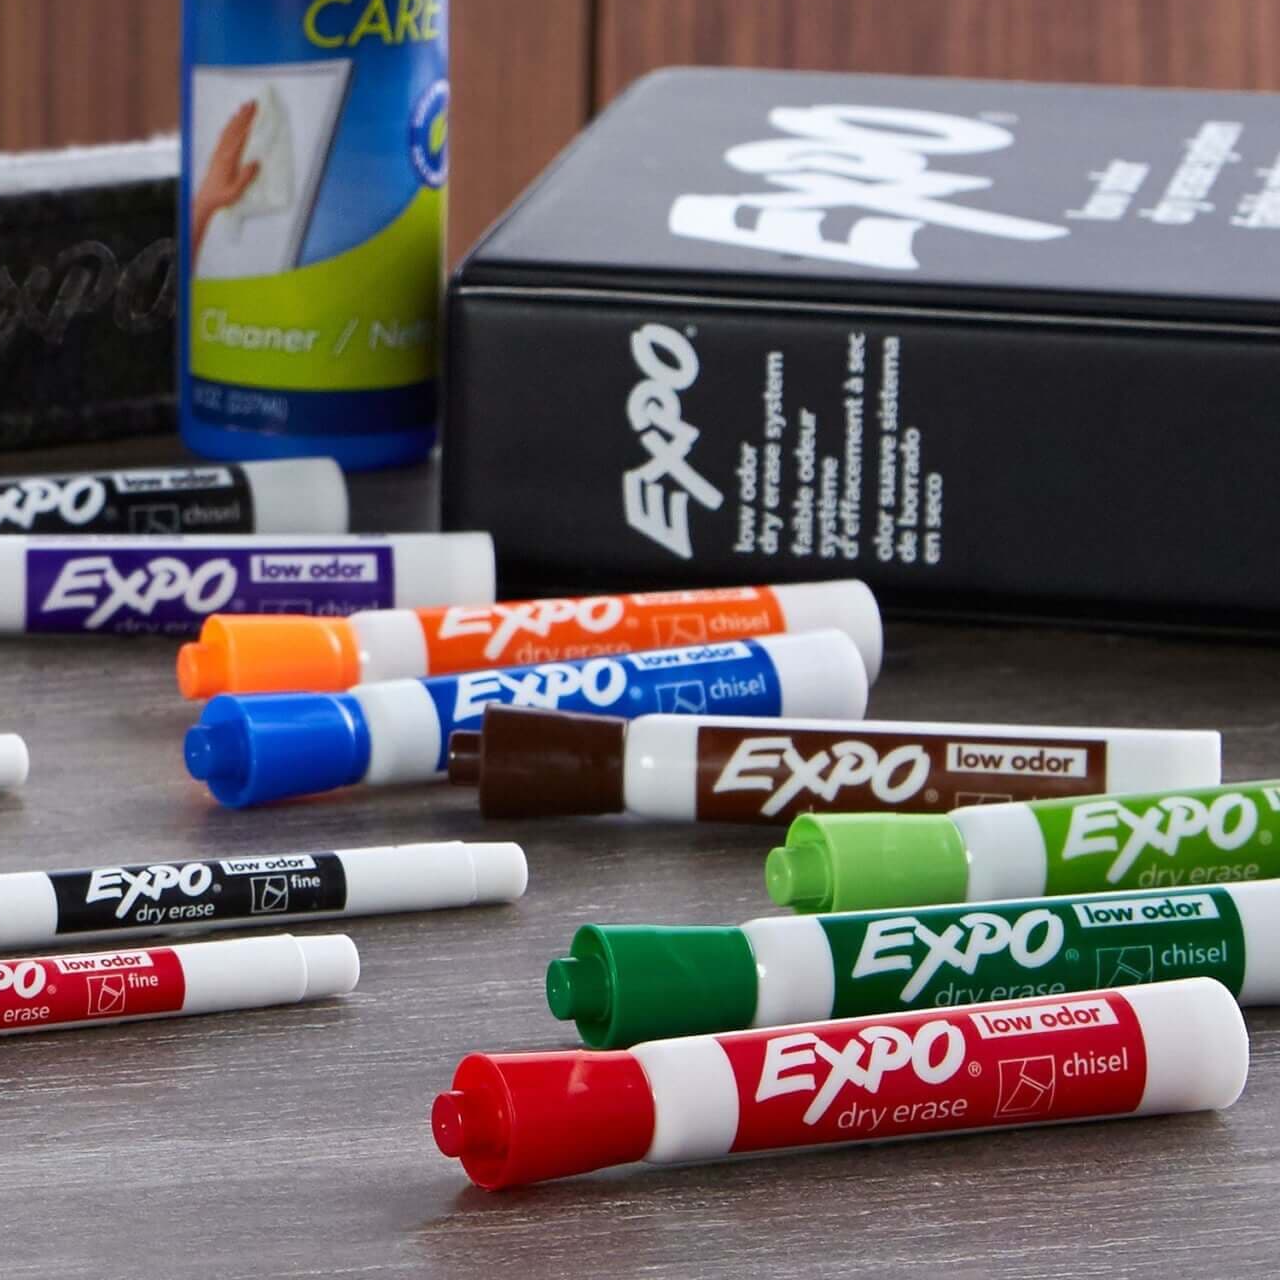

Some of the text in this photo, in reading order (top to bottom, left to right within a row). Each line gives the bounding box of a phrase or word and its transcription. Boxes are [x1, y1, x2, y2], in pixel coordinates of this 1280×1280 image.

[668, 102, 1071, 270] EXPO
[200, 308, 318, 353] Cleaner
[848, 332, 866, 373] sec
[623, 323, 724, 559] EXPO
[758, 351, 787, 555] dry erase system
[874, 336, 900, 561] olor suave sistema
[733, 443, 759, 553] low odor
[791, 408, 817, 557] faible odeur
[897, 428, 921, 563] de borrado
[924, 473, 943, 564] en seco
[260, 556, 365, 578] low odor
[42, 556, 238, 628] EXPO
[438, 596, 624, 660] EXPO
[710, 610, 770, 634] chisel
[453, 658, 627, 722] EXPO
[709, 675, 766, 700] chisel
[714, 737, 930, 817] EXPO
[956, 746, 1074, 773] low odor
[1062, 793, 1258, 884] EXPO
[228, 856, 305, 872] low odor
[290, 873, 321, 890] fine
[1190, 863, 1260, 884] erase
[85, 862, 212, 919] EXPO
[1083, 898, 1204, 925] low odor
[135, 902, 215, 925] dry erase
[62, 953, 141, 971] low odor
[852, 908, 1064, 1003] EXPO
[1161, 940, 1228, 968] chisel
[127, 972, 159, 989] fine
[4, 1005, 50, 1022] erase
[982, 1005, 1101, 1035] low odor
[755, 1019, 967, 1125] EXPO
[1063, 1047, 1129, 1078] chisel
[837, 1097, 968, 1132] dry erase
